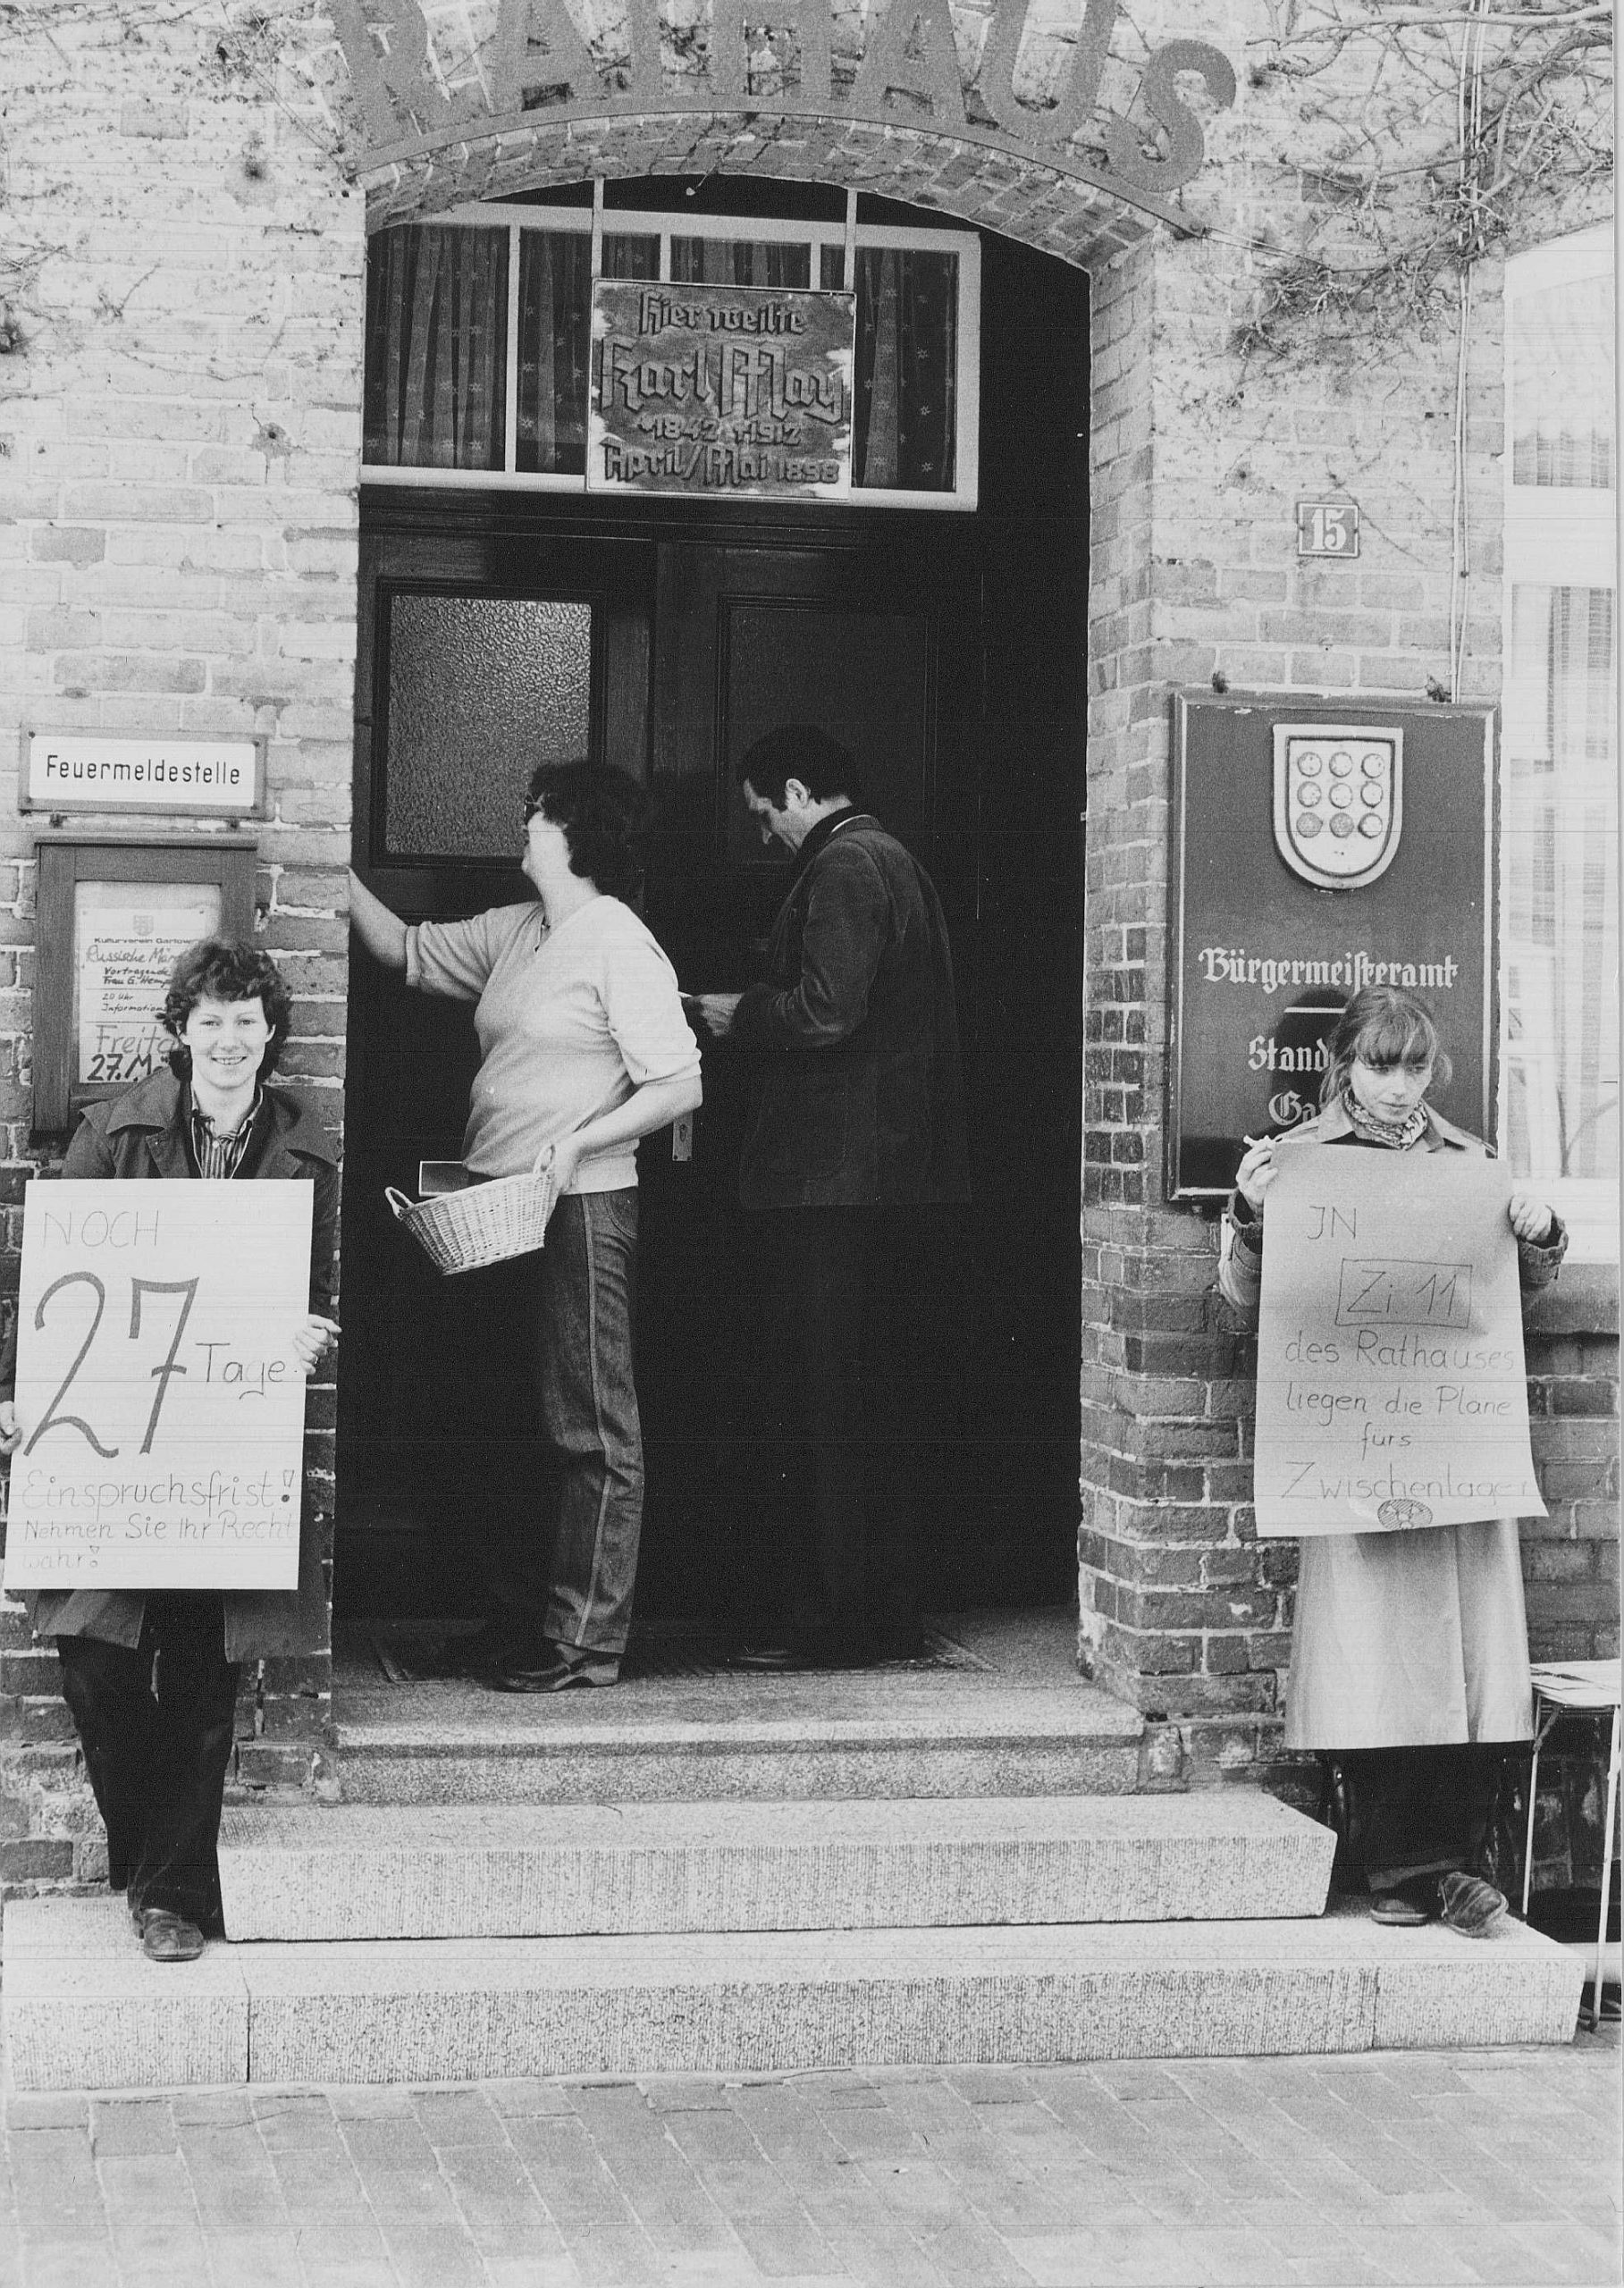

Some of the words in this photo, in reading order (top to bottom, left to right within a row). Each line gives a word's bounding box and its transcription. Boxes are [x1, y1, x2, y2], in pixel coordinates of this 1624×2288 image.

[640, 290, 700, 335] Hier
[709, 303, 806, 335] weilte
[600, 334, 712, 412] Karl
[718, 340, 844, 425] May
[1311, 509, 1347, 551] 15
[46, 754, 240, 785] Feuermeldestelle
[96, 1025, 175, 1054] Freita
[1249, 1036, 1332, 1072] Stand
[44, 1210, 159, 1248] NOCH
[1416, 1274, 1457, 1316] 11
[23, 1270, 199, 1458] 27
[1285, 1330, 1340, 1363] des
[1356, 1329, 1515, 1370] Rathauses
[1286, 1382, 1367, 1426] liegen
[1385, 1386, 1423, 1416] die
[21, 1469, 295, 1521] Einspruchsfrist!
[1282, 1461, 1529, 1505] Zwischenlager
[24, 1518, 114, 1540] Nehmen
[125, 1513, 167, 1540] Sie
[179, 1517, 212, 1540] Ihr
[218, 1510, 295, 1540] Recht
